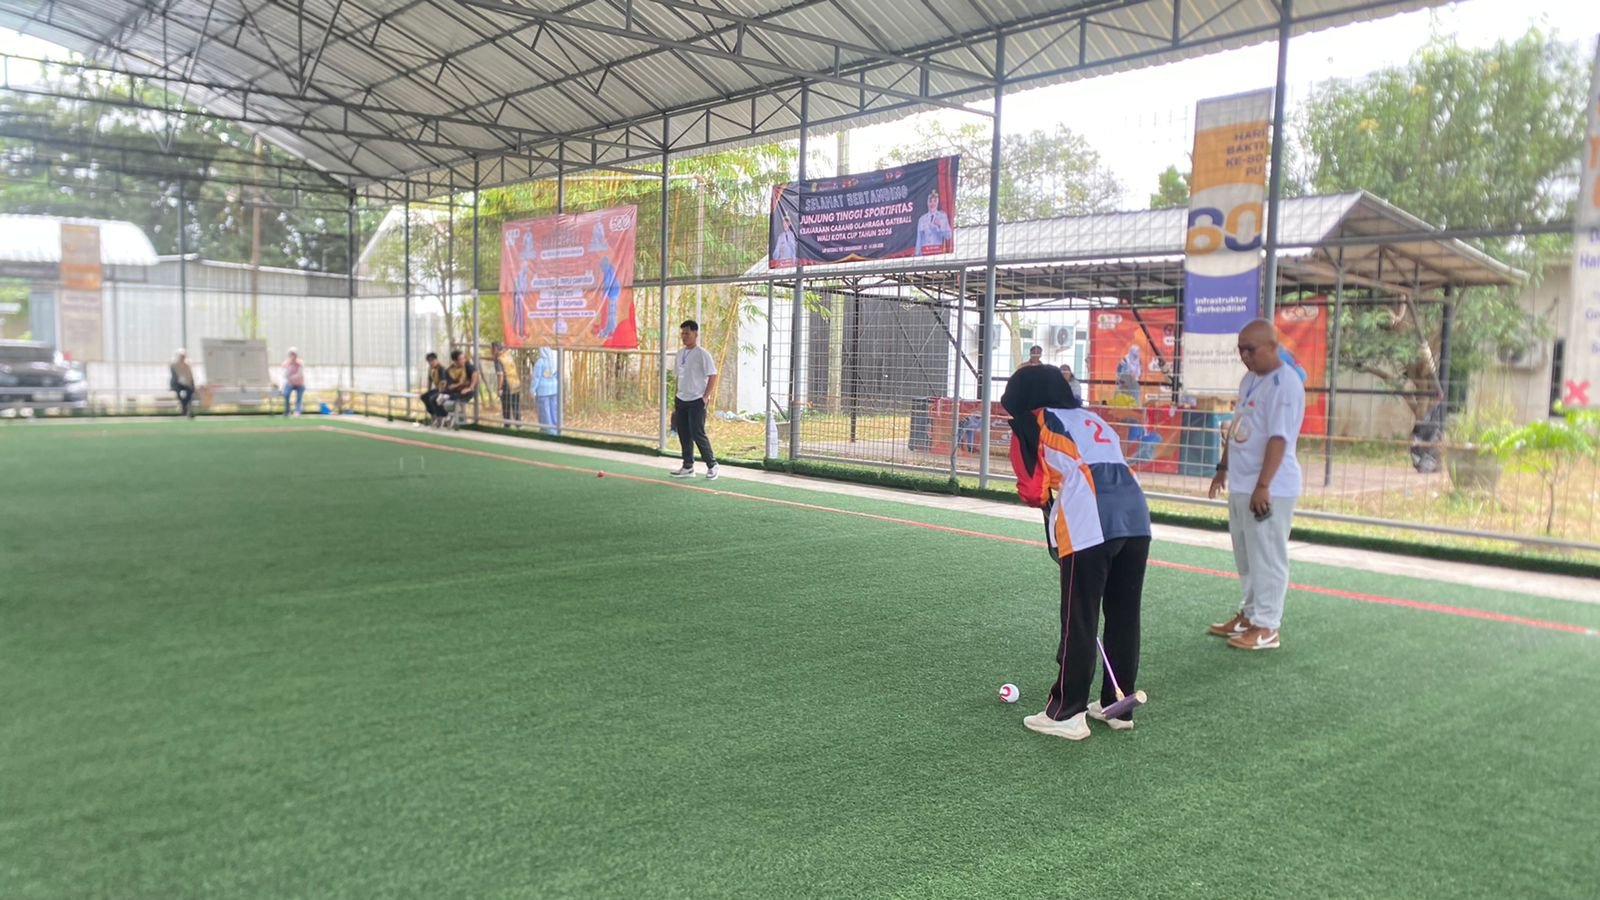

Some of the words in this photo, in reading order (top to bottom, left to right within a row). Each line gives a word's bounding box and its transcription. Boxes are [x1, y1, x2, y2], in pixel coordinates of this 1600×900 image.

[1233, 128, 1265, 141] HARI
[1226, 141, 1264, 154] BAKTI
[805, 194, 844, 212] SELAMAT
[847, 185, 908, 206] BERTANDING
[800, 213, 835, 225] JUNJUNG
[836, 209, 863, 221] TINGGI
[864, 202, 913, 218] SPORTIFITAS
[831, 223, 853, 232] CABANG
[854, 219, 885, 230] OLAHRAGA
[885, 216, 912, 226] GATEBALL
[817, 234, 830, 242] WALI
[831, 232, 846, 241] KOTA
[847, 231, 858, 240] CUP
[858, 229, 877, 238] TAHUN
[1195, 295, 1248, 305] Infrastruktur
[1196, 304, 1247, 313] Berkeadilan
[1084, 419, 1112, 443] 2
